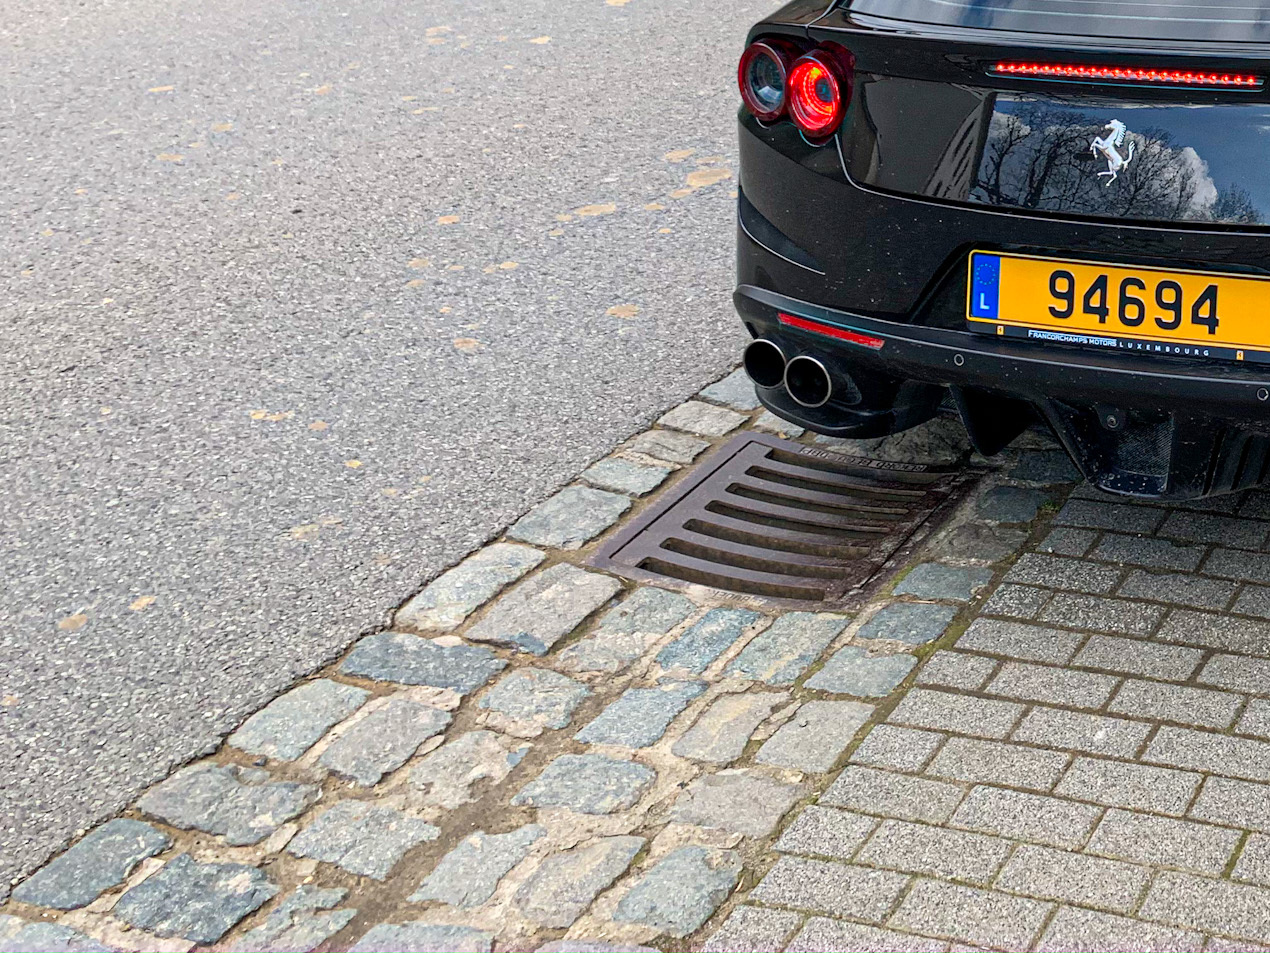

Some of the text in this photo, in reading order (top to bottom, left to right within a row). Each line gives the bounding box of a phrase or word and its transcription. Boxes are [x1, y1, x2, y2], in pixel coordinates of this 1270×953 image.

[979, 293, 990, 310] L
[1048, 269, 1220, 336] 94694
[1088, 337, 1117, 347] MOTORS
[1119, 341, 1209, 356] LUXEMBOURG
